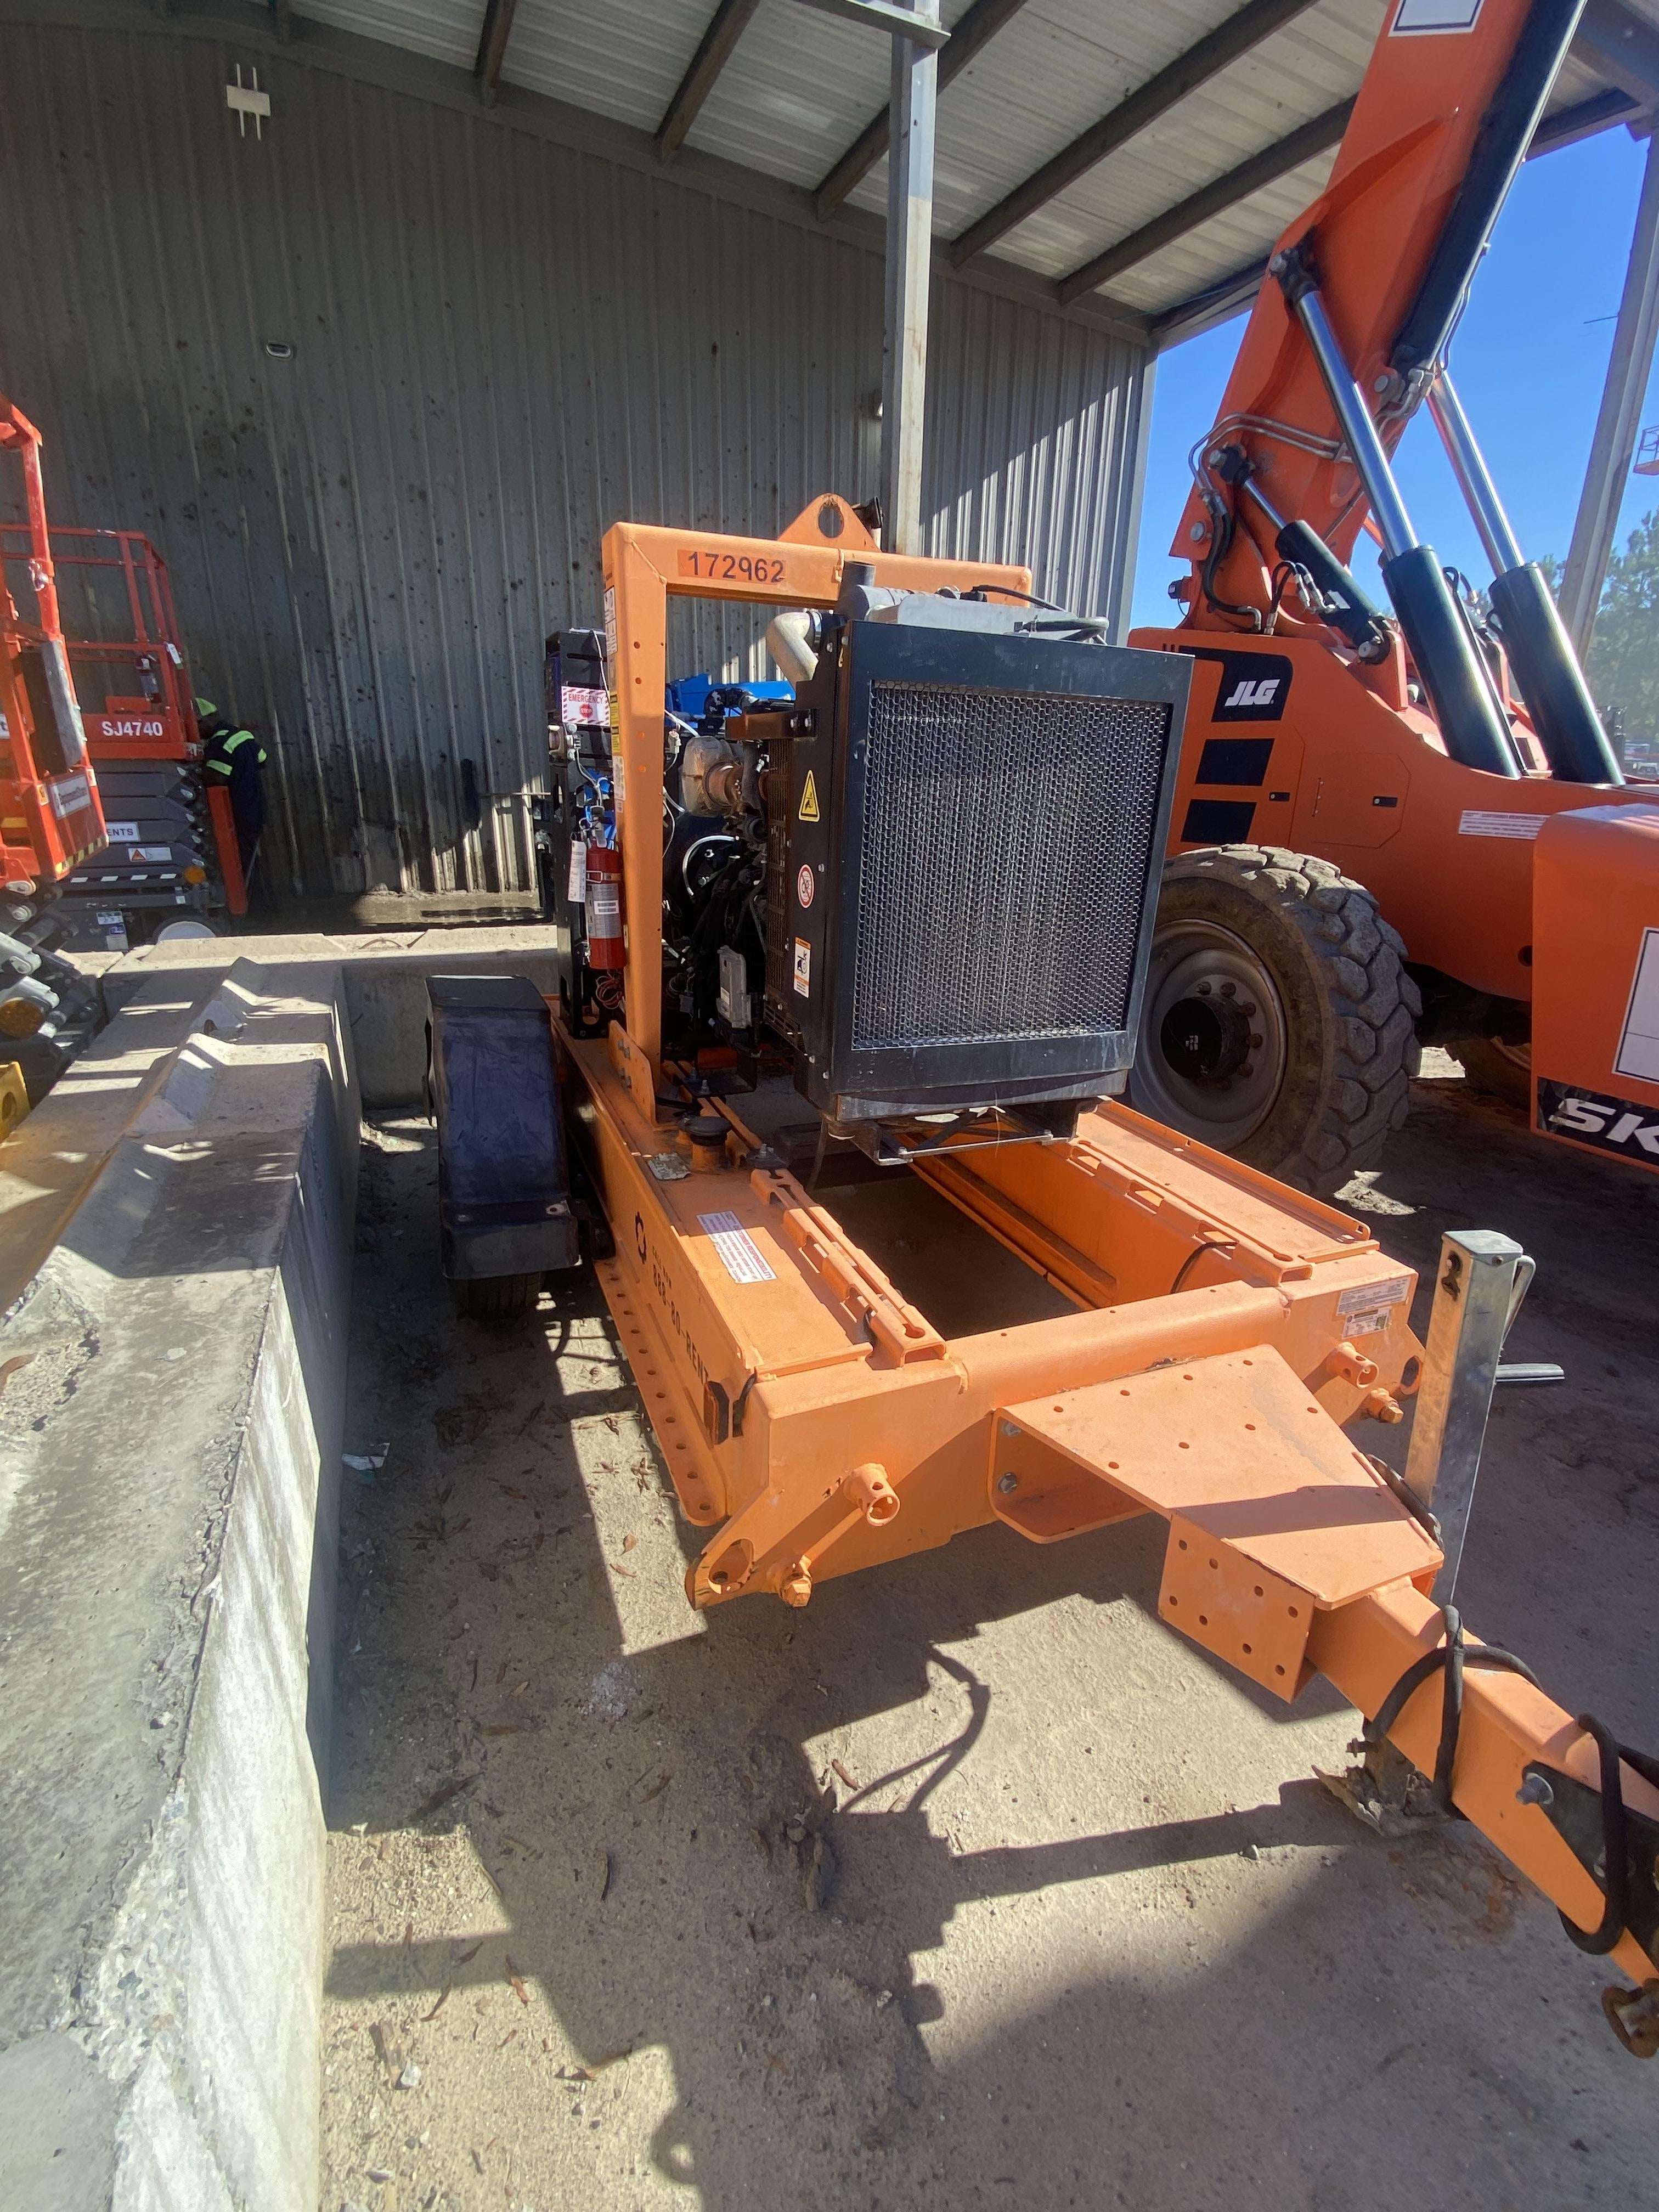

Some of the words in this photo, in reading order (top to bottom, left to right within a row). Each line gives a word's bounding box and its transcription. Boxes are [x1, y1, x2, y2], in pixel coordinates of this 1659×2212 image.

[688, 551, 785, 583] 172962
[568, 693, 603, 704] EMERGENCY
[1224, 679, 1280, 707] JLG
[101, 721, 163, 736] SJ4740
